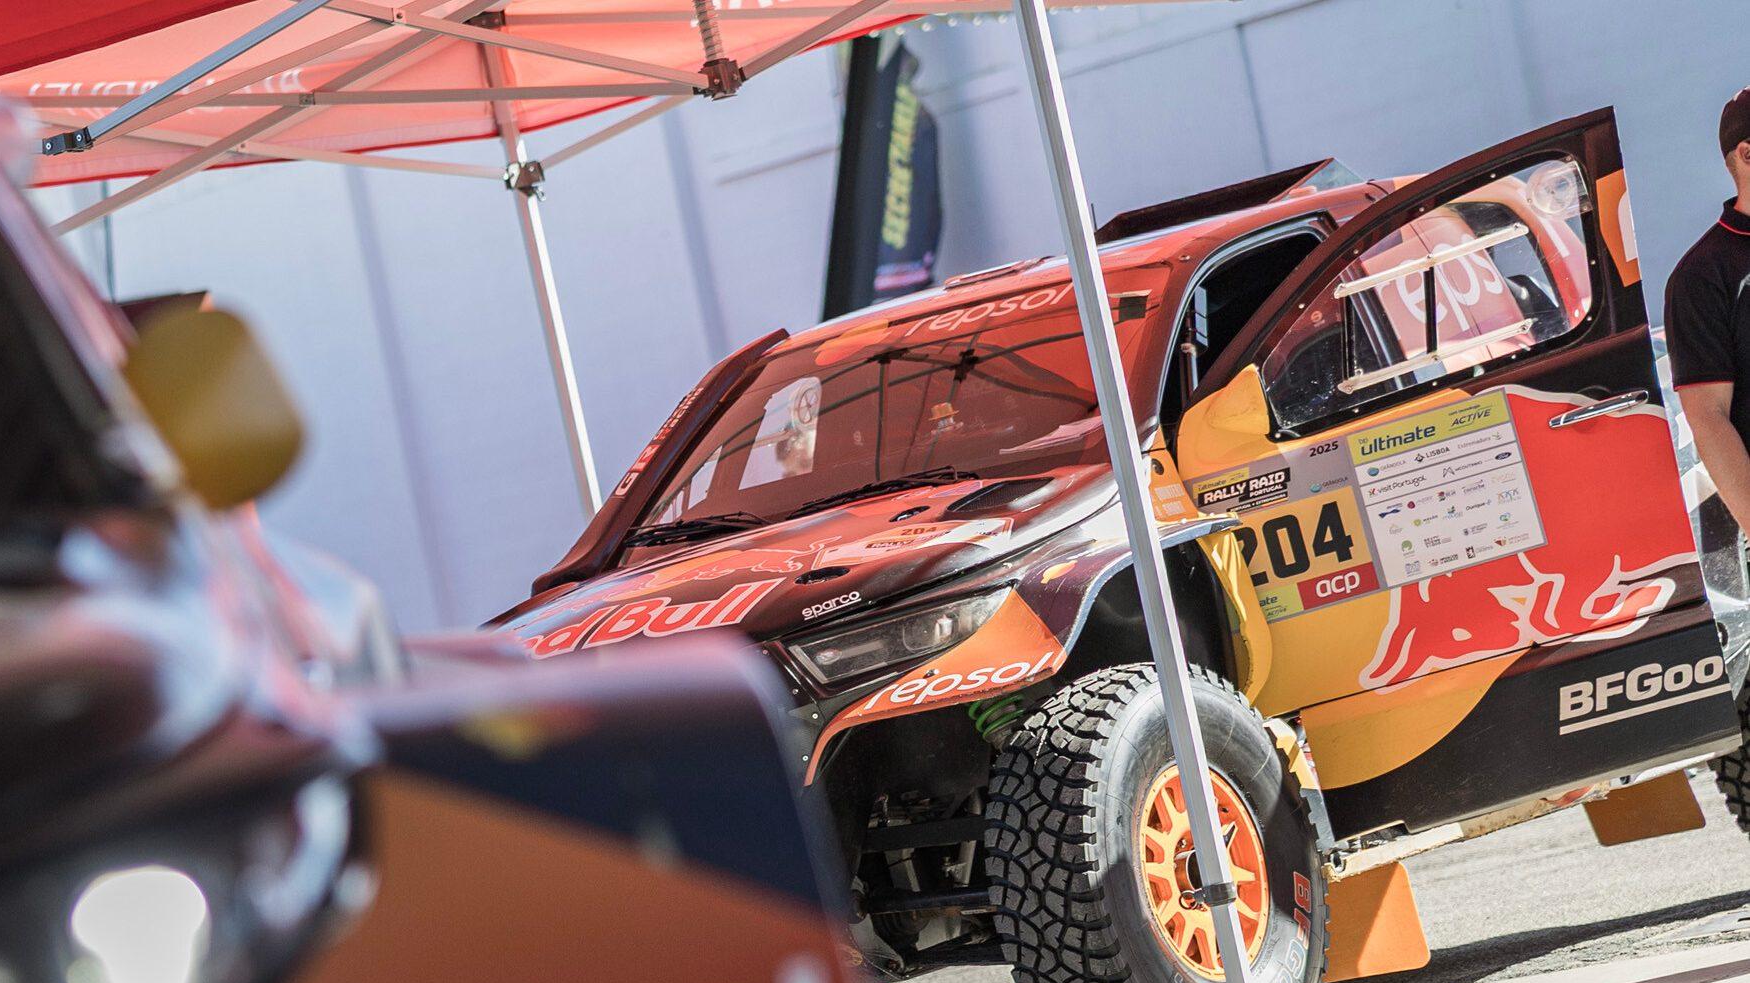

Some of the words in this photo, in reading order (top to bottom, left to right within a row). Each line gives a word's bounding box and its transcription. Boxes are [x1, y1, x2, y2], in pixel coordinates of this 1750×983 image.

[905, 283, 1073, 337] repsol
[1451, 409, 1492, 427] ACTIVE
[1309, 441, 1339, 457] 2025
[1361, 425, 1436, 456] ultimate
[1426, 446, 1450, 458] LISBOA
[615, 444, 660, 496] GR
[1392, 475, 1427, 489] Portugal
[1203, 481, 1247, 505] RALLY
[1250, 471, 1286, 491] RAID
[1250, 483, 1284, 498] PORTUGAL
[1231, 501, 1354, 587] 204
[1315, 571, 1360, 598] acp
[581, 577, 787, 651] Bull
[801, 590, 860, 620] sparco
[864, 652, 1054, 710] repsol
[1559, 655, 1728, 721] BFGoo
